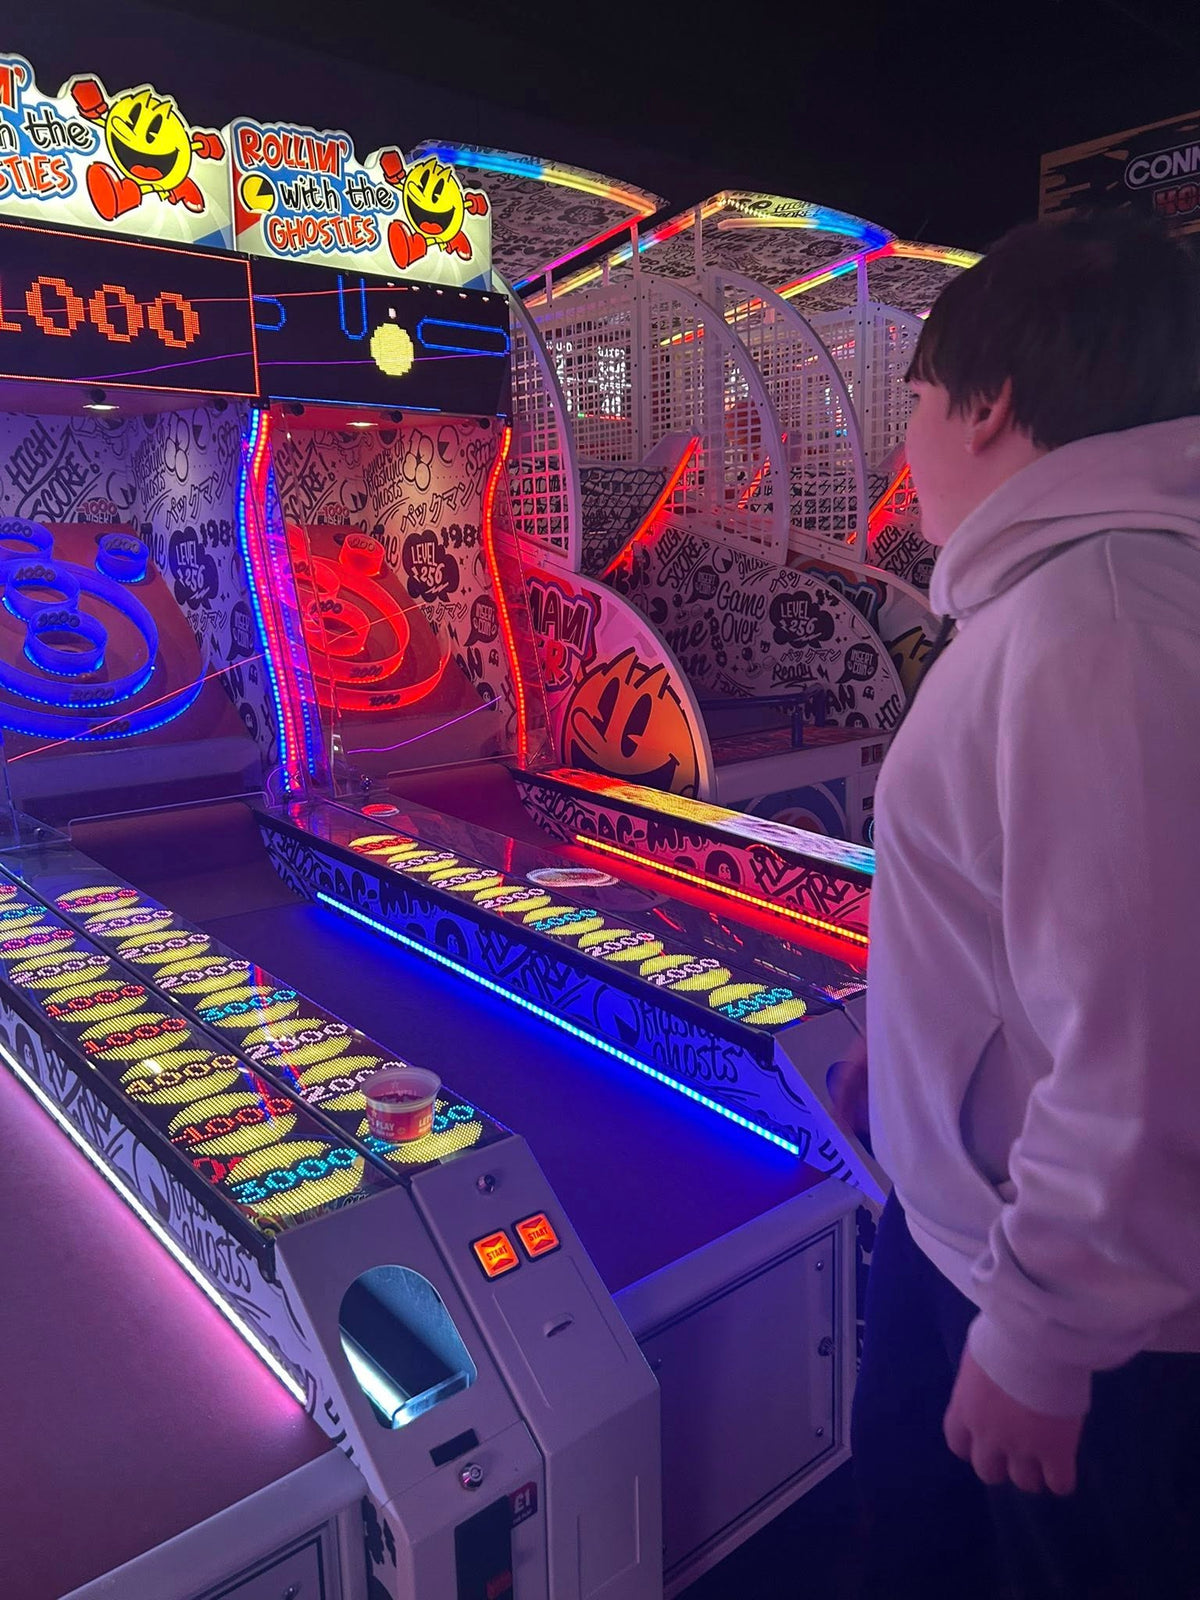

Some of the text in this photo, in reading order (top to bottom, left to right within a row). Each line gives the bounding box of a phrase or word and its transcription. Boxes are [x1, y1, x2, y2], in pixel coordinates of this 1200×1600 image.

[25, 109, 93, 150] the
[239, 128, 347, 176] ROLLIN'
[0, 156, 70, 193] TIES
[279, 175, 395, 212] with the
[268, 216, 378, 251] GHOSTIES
[5, 419, 58, 495] HIGH
[175, 541, 200, 570] LEVEL
[410, 541, 438, 567] LEVEL
[420, 563, 445, 587] 256
[715, 580, 766, 620] Game
[781, 600, 809, 620] LEVEL
[721, 612, 760, 645] Over
[788, 617, 818, 637] 256
[389, 852, 455, 870] 2000
[431, 869, 498, 889] 2000
[57, 888, 138, 910] 1000
[478, 887, 545, 908] 2000
[85, 910, 173, 934] 2000
[529, 908, 598, 931] 3000
[118, 933, 210, 960] 2000
[584, 932, 655, 957] 2000
[9, 955, 111, 984] 2000
[155, 960, 250, 989] 2000
[648, 958, 721, 986] 2000
[45, 985, 145, 1017] 1000
[199, 989, 297, 1022] 3000
[719, 987, 793, 1019] 3000
[82, 1018, 188, 1054] 1000
[244, 1023, 349, 1060] 2000
[231, 1148, 359, 1204] 3000
[527, 1226, 549, 1242] START
[486, 1245, 508, 1261] START
